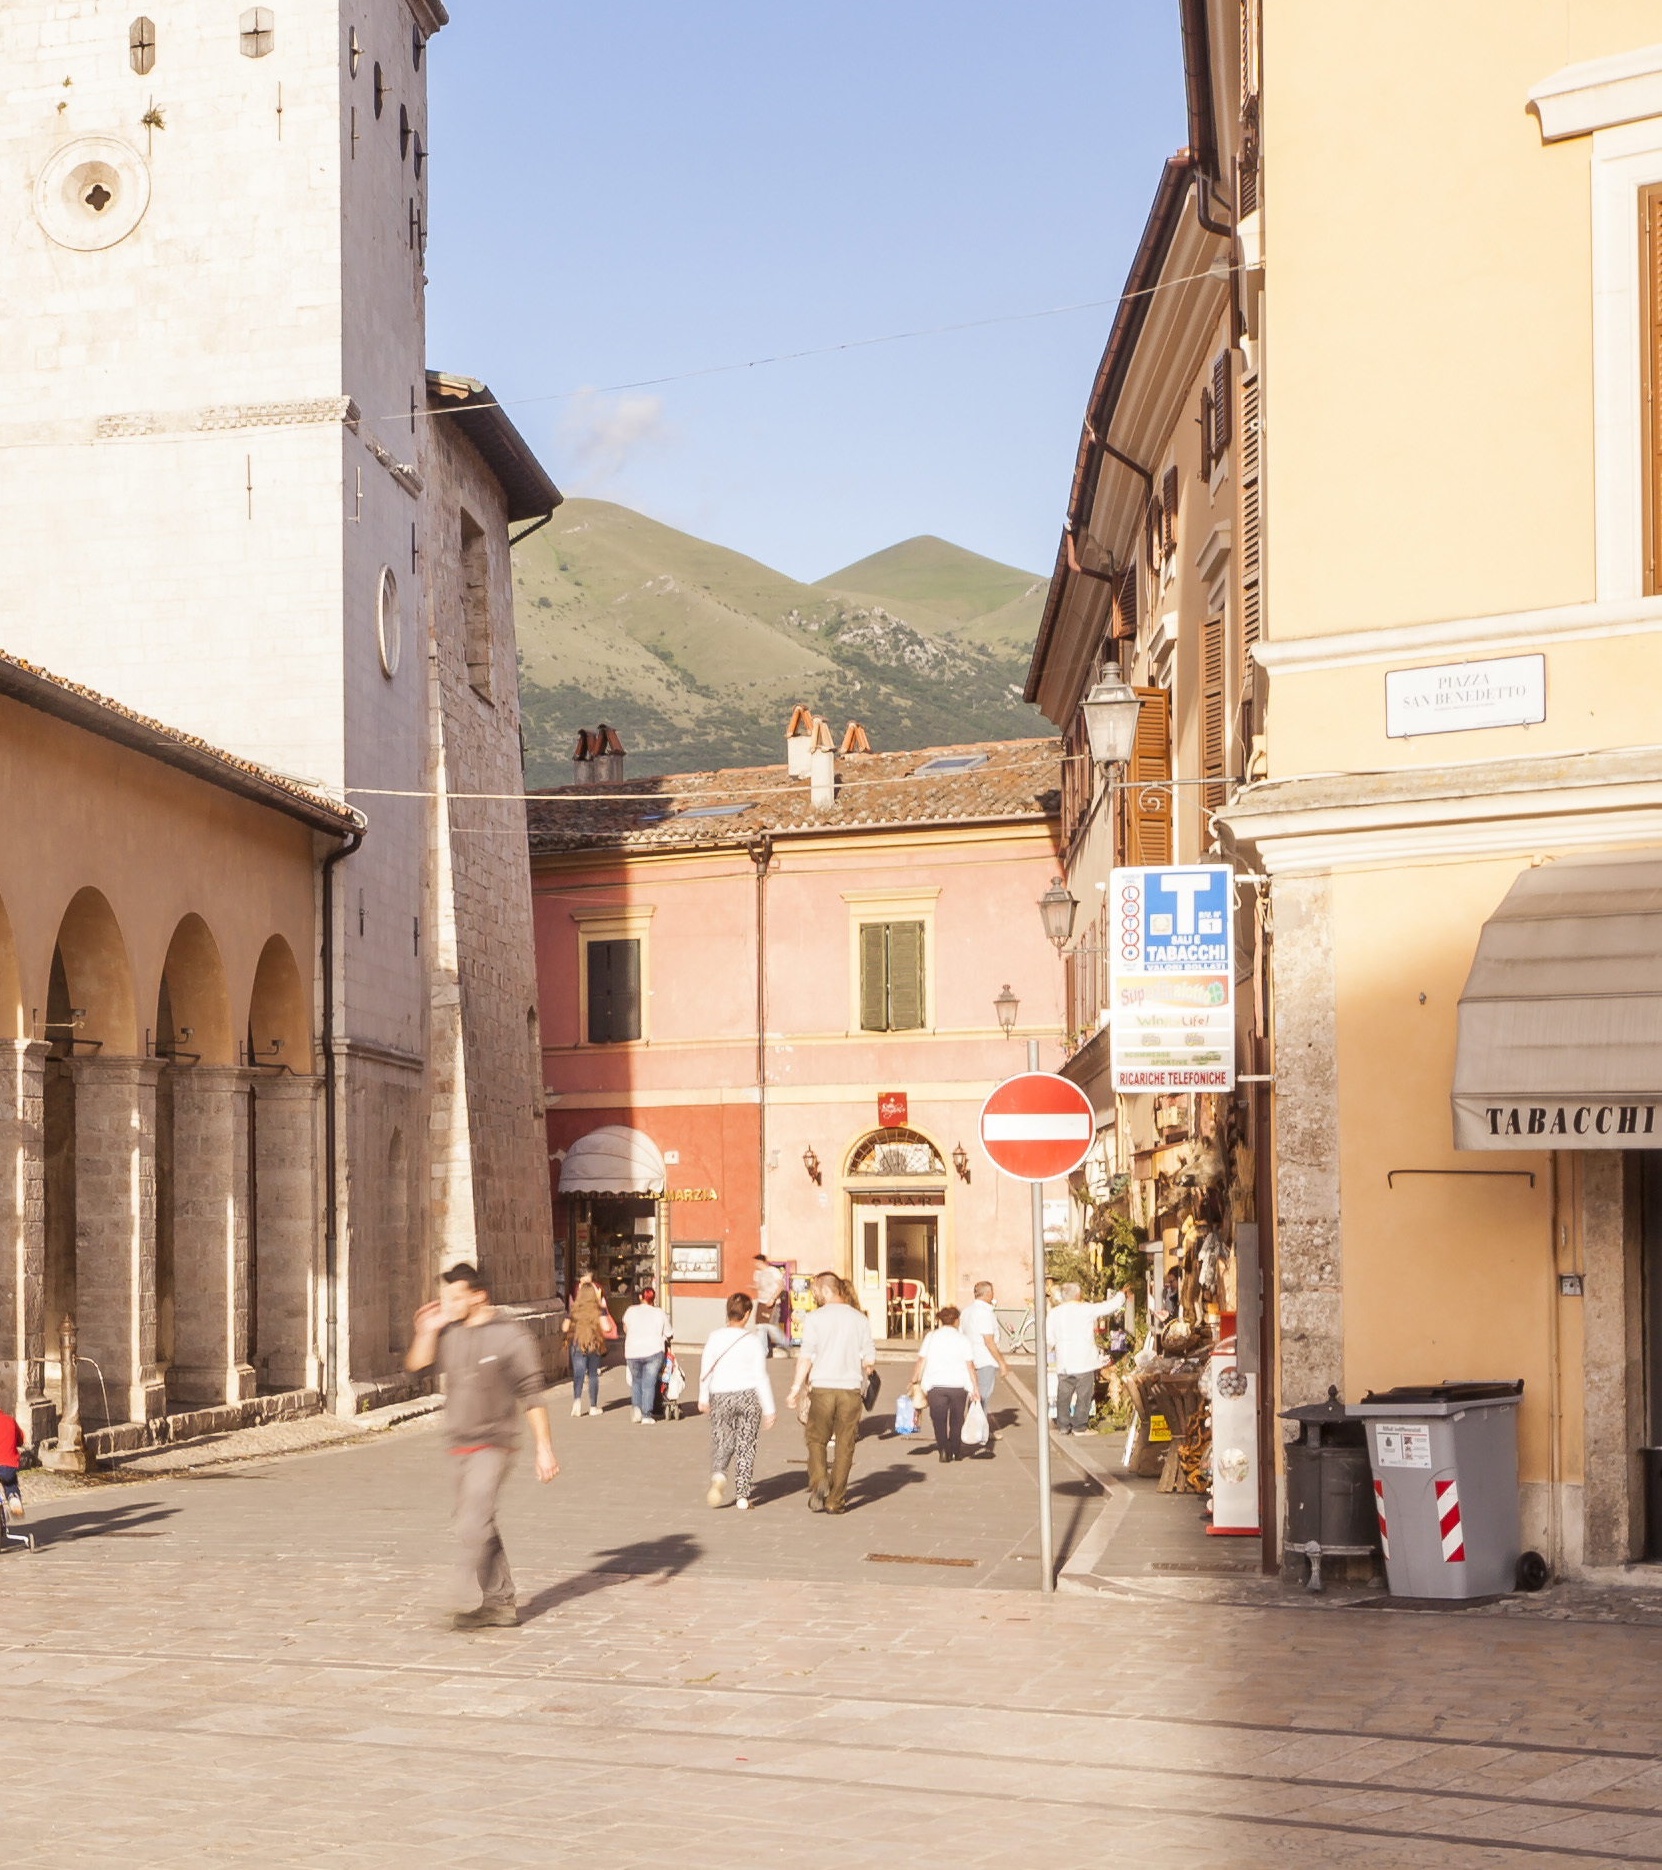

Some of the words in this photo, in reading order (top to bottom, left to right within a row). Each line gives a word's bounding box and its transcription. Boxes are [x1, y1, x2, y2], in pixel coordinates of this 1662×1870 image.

[1438, 674, 1490, 690] PIAZZA
[1403, 693, 1431, 708] SAN
[1435, 685, 1527, 706] BENEDETTO
[1160, 873, 1211, 935] T
[1146, 944, 1226, 961] TABACCHI
[1119, 1072, 1166, 1086] RICARICHE
[1168, 1071, 1227, 1085] TELEFONICHE
[1485, 1106, 1656, 1135] TABACCHI
[664, 1188, 718, 1202] MARZIA
